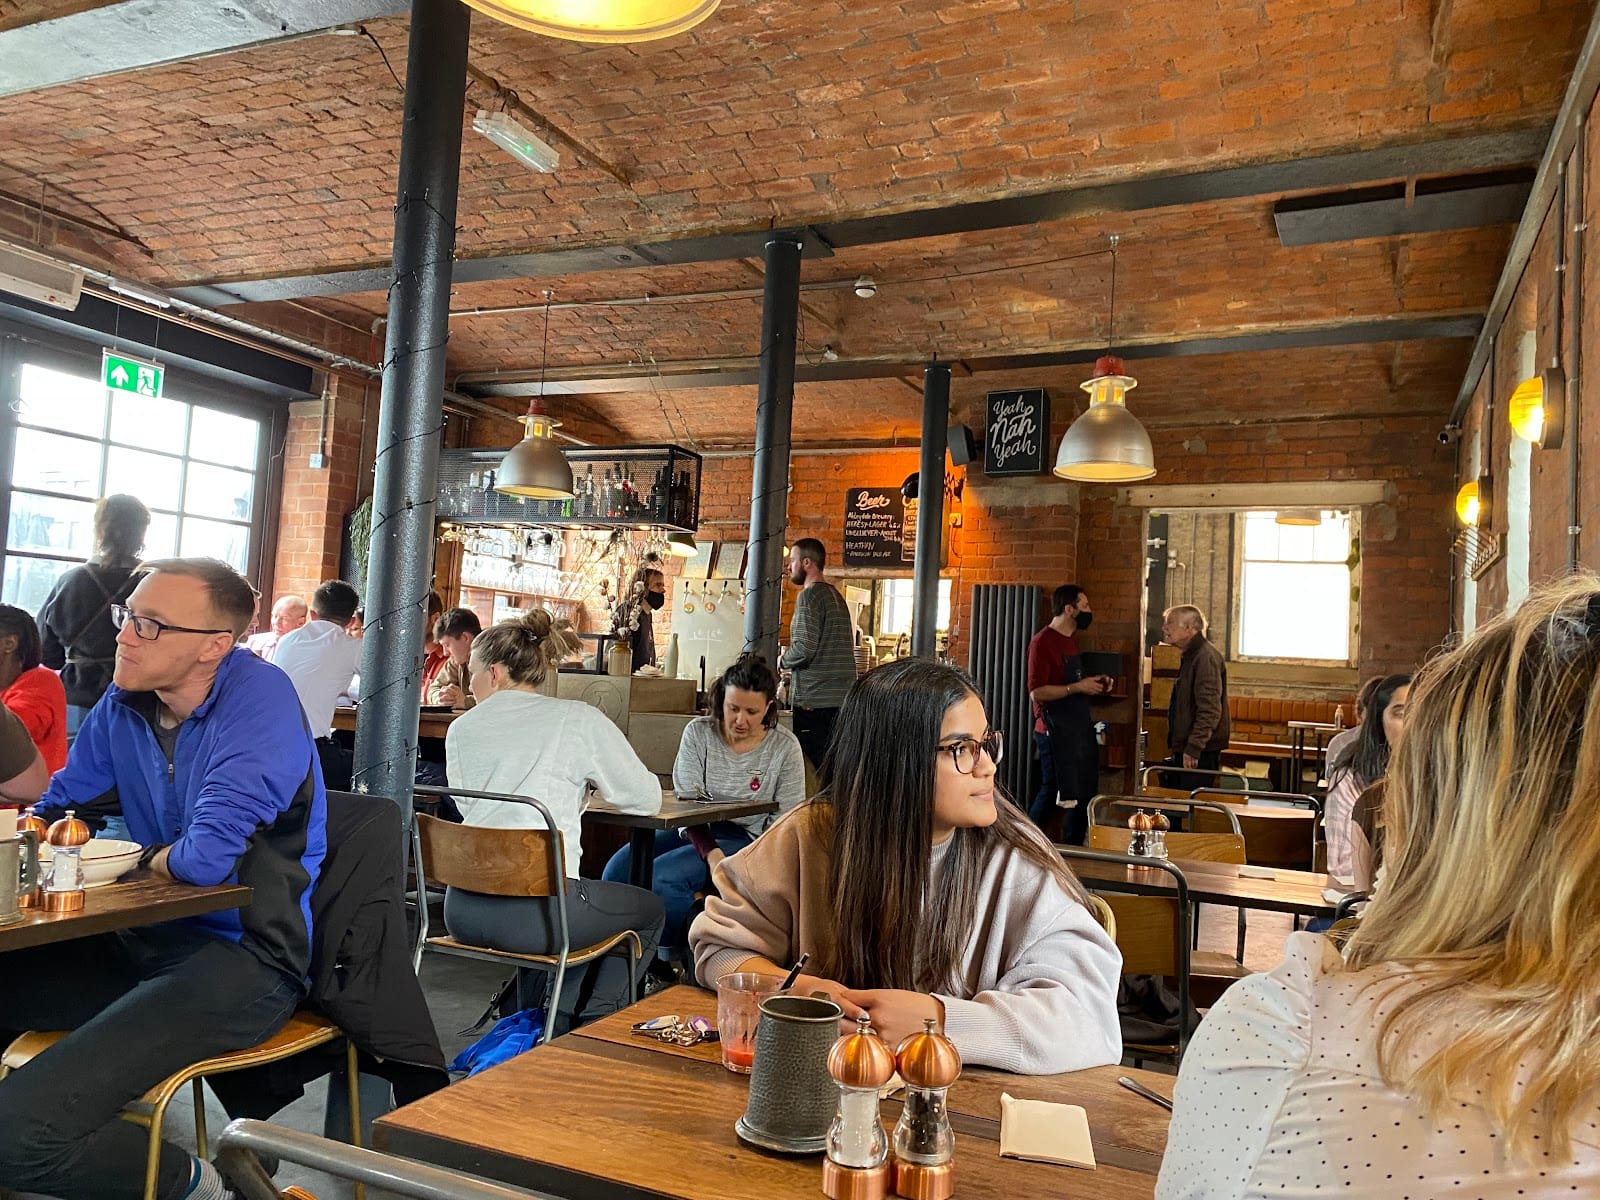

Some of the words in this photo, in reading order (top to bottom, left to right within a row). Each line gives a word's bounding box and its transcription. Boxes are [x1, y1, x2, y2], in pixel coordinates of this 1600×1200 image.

[993, 395, 1026, 422] Yeah
[990, 405, 1036, 448] Nah
[994, 432, 1036, 468] Yeah
[856, 490, 891, 511] Beer
